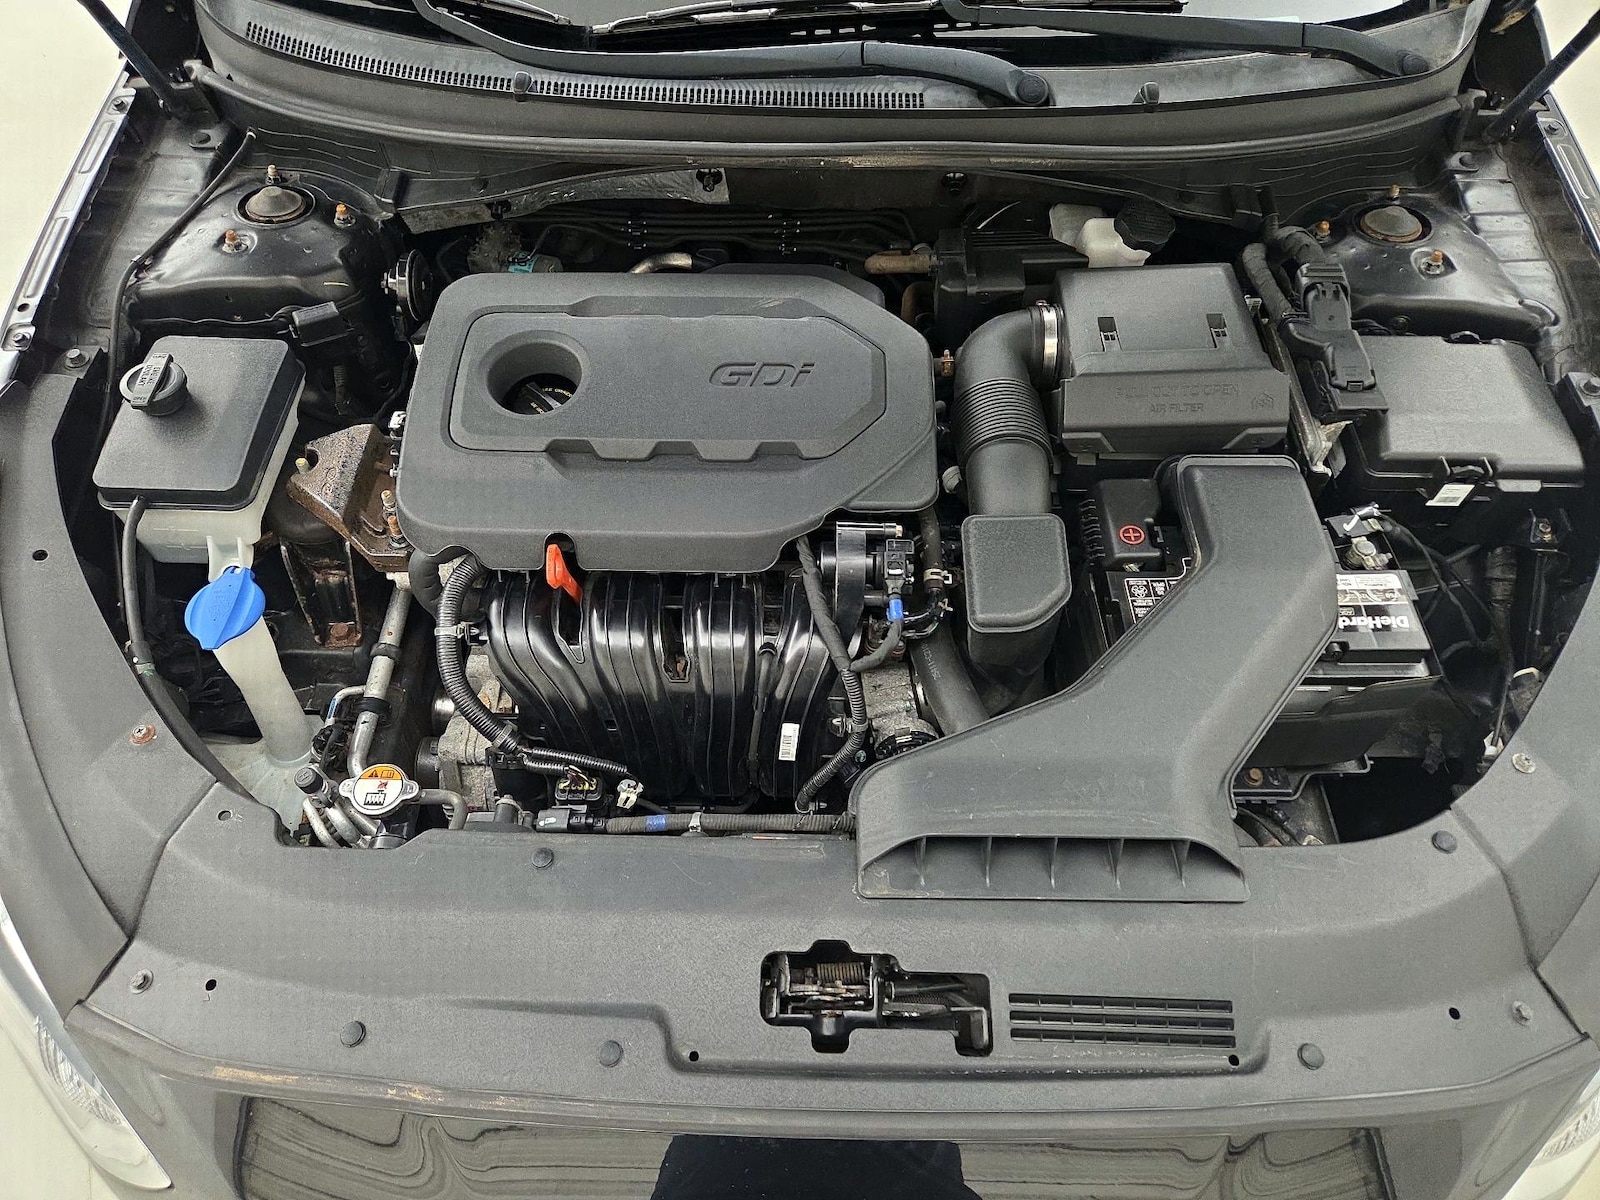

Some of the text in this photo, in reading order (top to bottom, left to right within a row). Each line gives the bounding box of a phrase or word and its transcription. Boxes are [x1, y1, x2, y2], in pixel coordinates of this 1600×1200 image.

[1151, 402, 1204, 412] AIR FILTER
[1338, 615, 1409, 629] DieHard
